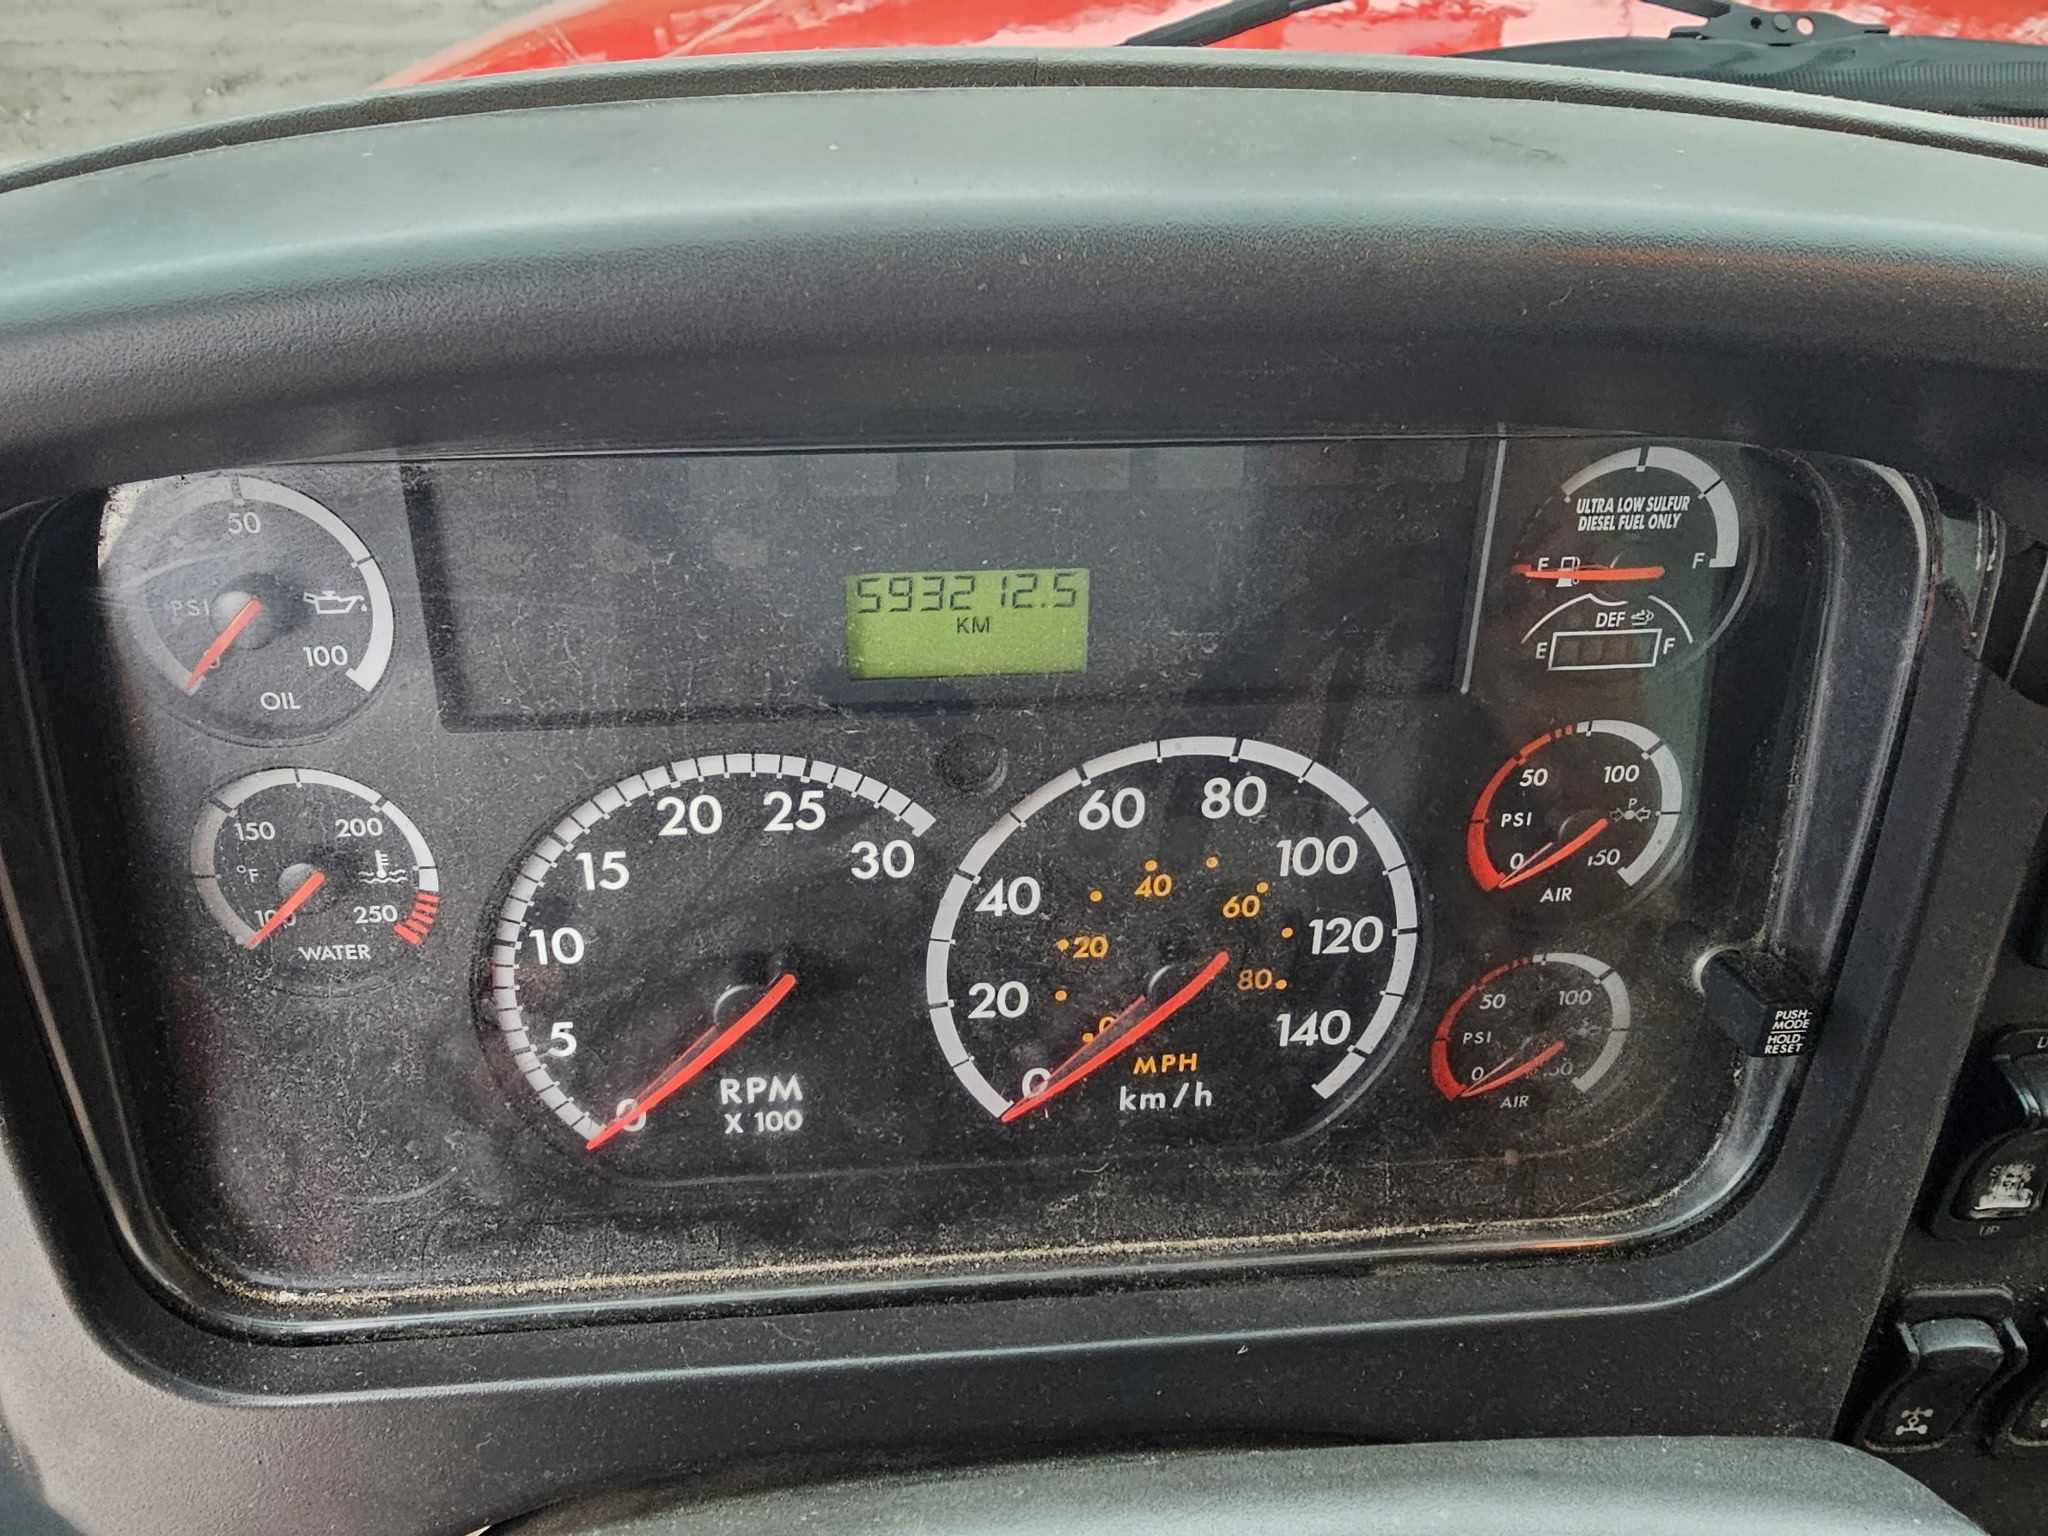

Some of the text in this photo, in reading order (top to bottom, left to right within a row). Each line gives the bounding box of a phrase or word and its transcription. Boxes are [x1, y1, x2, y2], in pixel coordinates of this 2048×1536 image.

[1576, 495, 1690, 514] ULTRA LOW SULFUR
[227, 512, 261, 534] 50
[1578, 513, 1682, 531] DIESEL FUEL ONLY
[1692, 552, 1705, 569] F
[170, 598, 210, 617] PSI
[956, 616, 990, 634] KM
[1595, 611, 1626, 628] DEF
[303, 645, 348, 667] 100
[1535, 642, 1548, 659] E
[1663, 638, 1676, 655] F
[260, 692, 300, 711] OIL
[1519, 768, 1548, 787] 50
[1603, 765, 1640, 783] 100
[1201, 776, 1267, 819] 80
[656, 794, 723, 836] 20
[763, 790, 826, 831] 25
[1078, 787, 1146, 831] 60
[335, 817, 383, 837] 200
[1501, 812, 1533, 828] PSI
[234, 821, 276, 841] 150
[850, 839, 916, 880] 30
[1275, 835, 1359, 876] 100
[576, 850, 631, 891] 15
[974, 876, 1041, 916] 40
[1134, 873, 1173, 898] 40
[1540, 887, 1573, 903] AIR
[353, 905, 398, 924] 250
[1222, 894, 1261, 918] 60
[1308, 915, 1384, 955] 120
[298, 944, 372, 961] WATER
[528, 926, 585, 966] 10
[1073, 935, 1109, 959] 20
[1236, 967, 1273, 991] 80
[967, 980, 1030, 1020] 20
[1479, 993, 1506, 1009] 50
[1558, 990, 1592, 1006] 100
[1275, 1009, 1352, 1048] 140
[1771, 1018, 1811, 1030] MODE
[546, 1021, 578, 1057] 5
[1463, 1031, 1492, 1045] PSI
[1764, 1043, 1804, 1055] RESET
[1133, 1053, 1198, 1075] MPH
[719, 1074, 804, 1105] RPM
[1119, 1084, 1213, 1112] km/h
[1500, 1095, 1529, 1109] AIR
[725, 1110, 803, 1133] X 100
